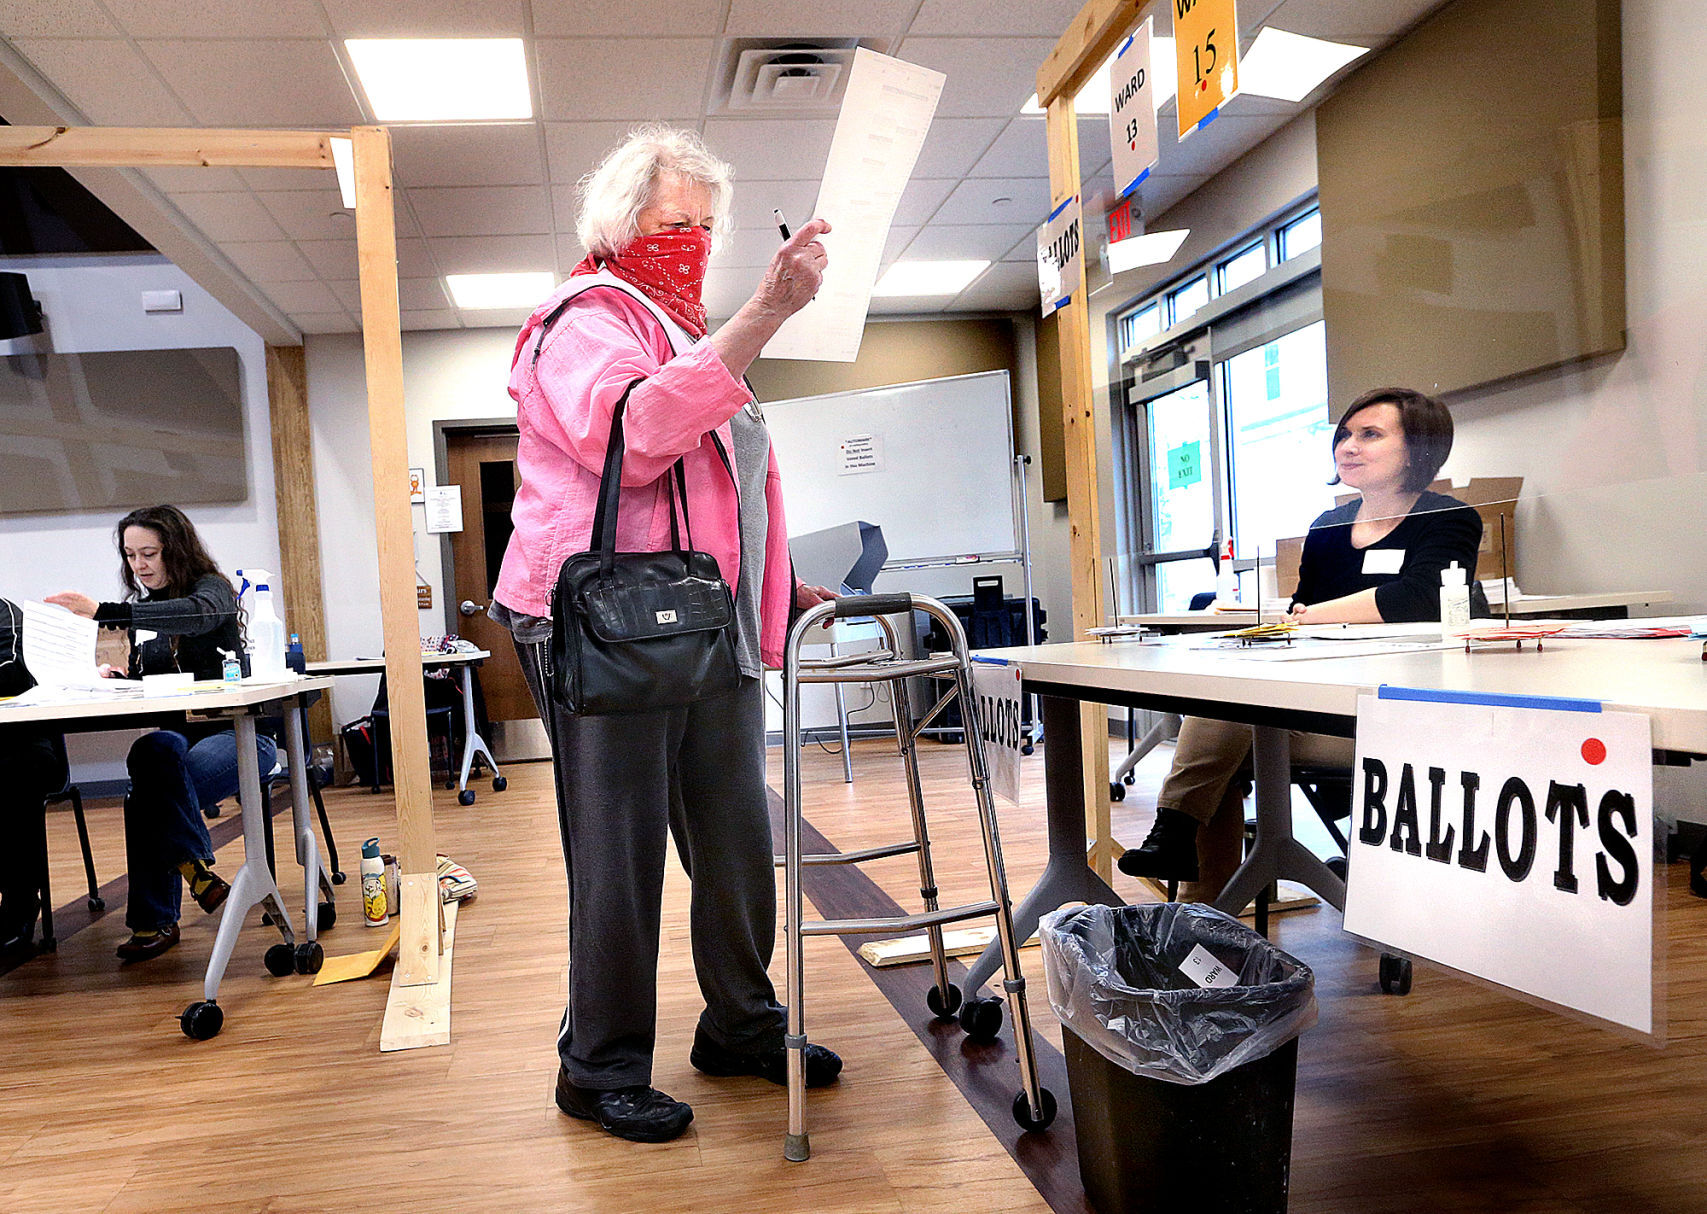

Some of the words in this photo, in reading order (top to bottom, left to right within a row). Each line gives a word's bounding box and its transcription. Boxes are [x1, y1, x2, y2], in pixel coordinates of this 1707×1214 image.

[1194, 28, 1216, 85] 15
[1114, 68, 1145, 113] WARD
[1126, 118, 1138, 143] 13
[1109, 200, 1131, 244] EXIT
[1180, 454, 1190, 463] NO
[979, 695, 1019, 751] LLOTS
[1359, 757, 1639, 906] BALLOTS
[1204, 965, 1223, 984] WARD
